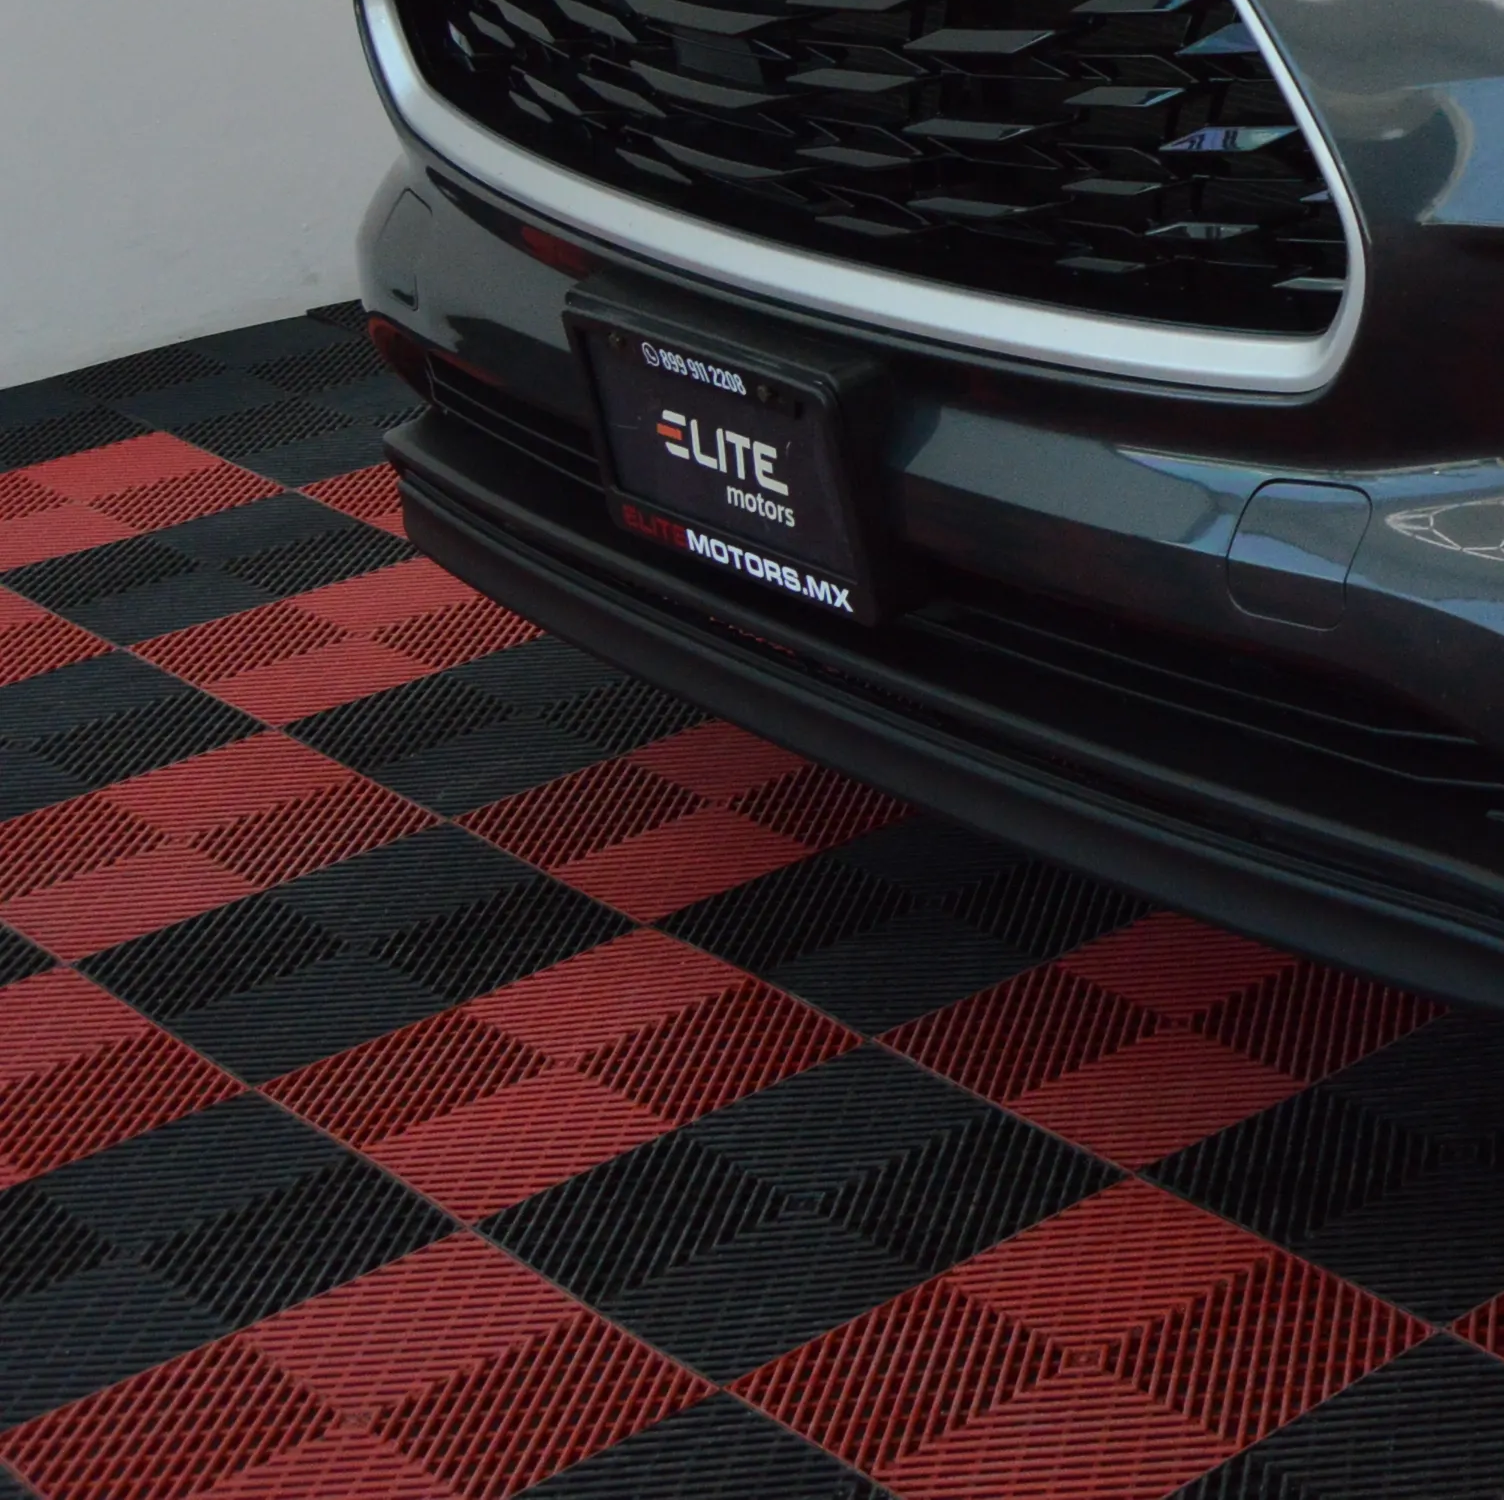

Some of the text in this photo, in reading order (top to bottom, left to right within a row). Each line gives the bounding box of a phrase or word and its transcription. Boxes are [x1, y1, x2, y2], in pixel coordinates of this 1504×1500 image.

[659, 348, 747, 396] 899 911 2208
[656, 409, 789, 496] ELITE
[726, 485, 796, 528] motors
